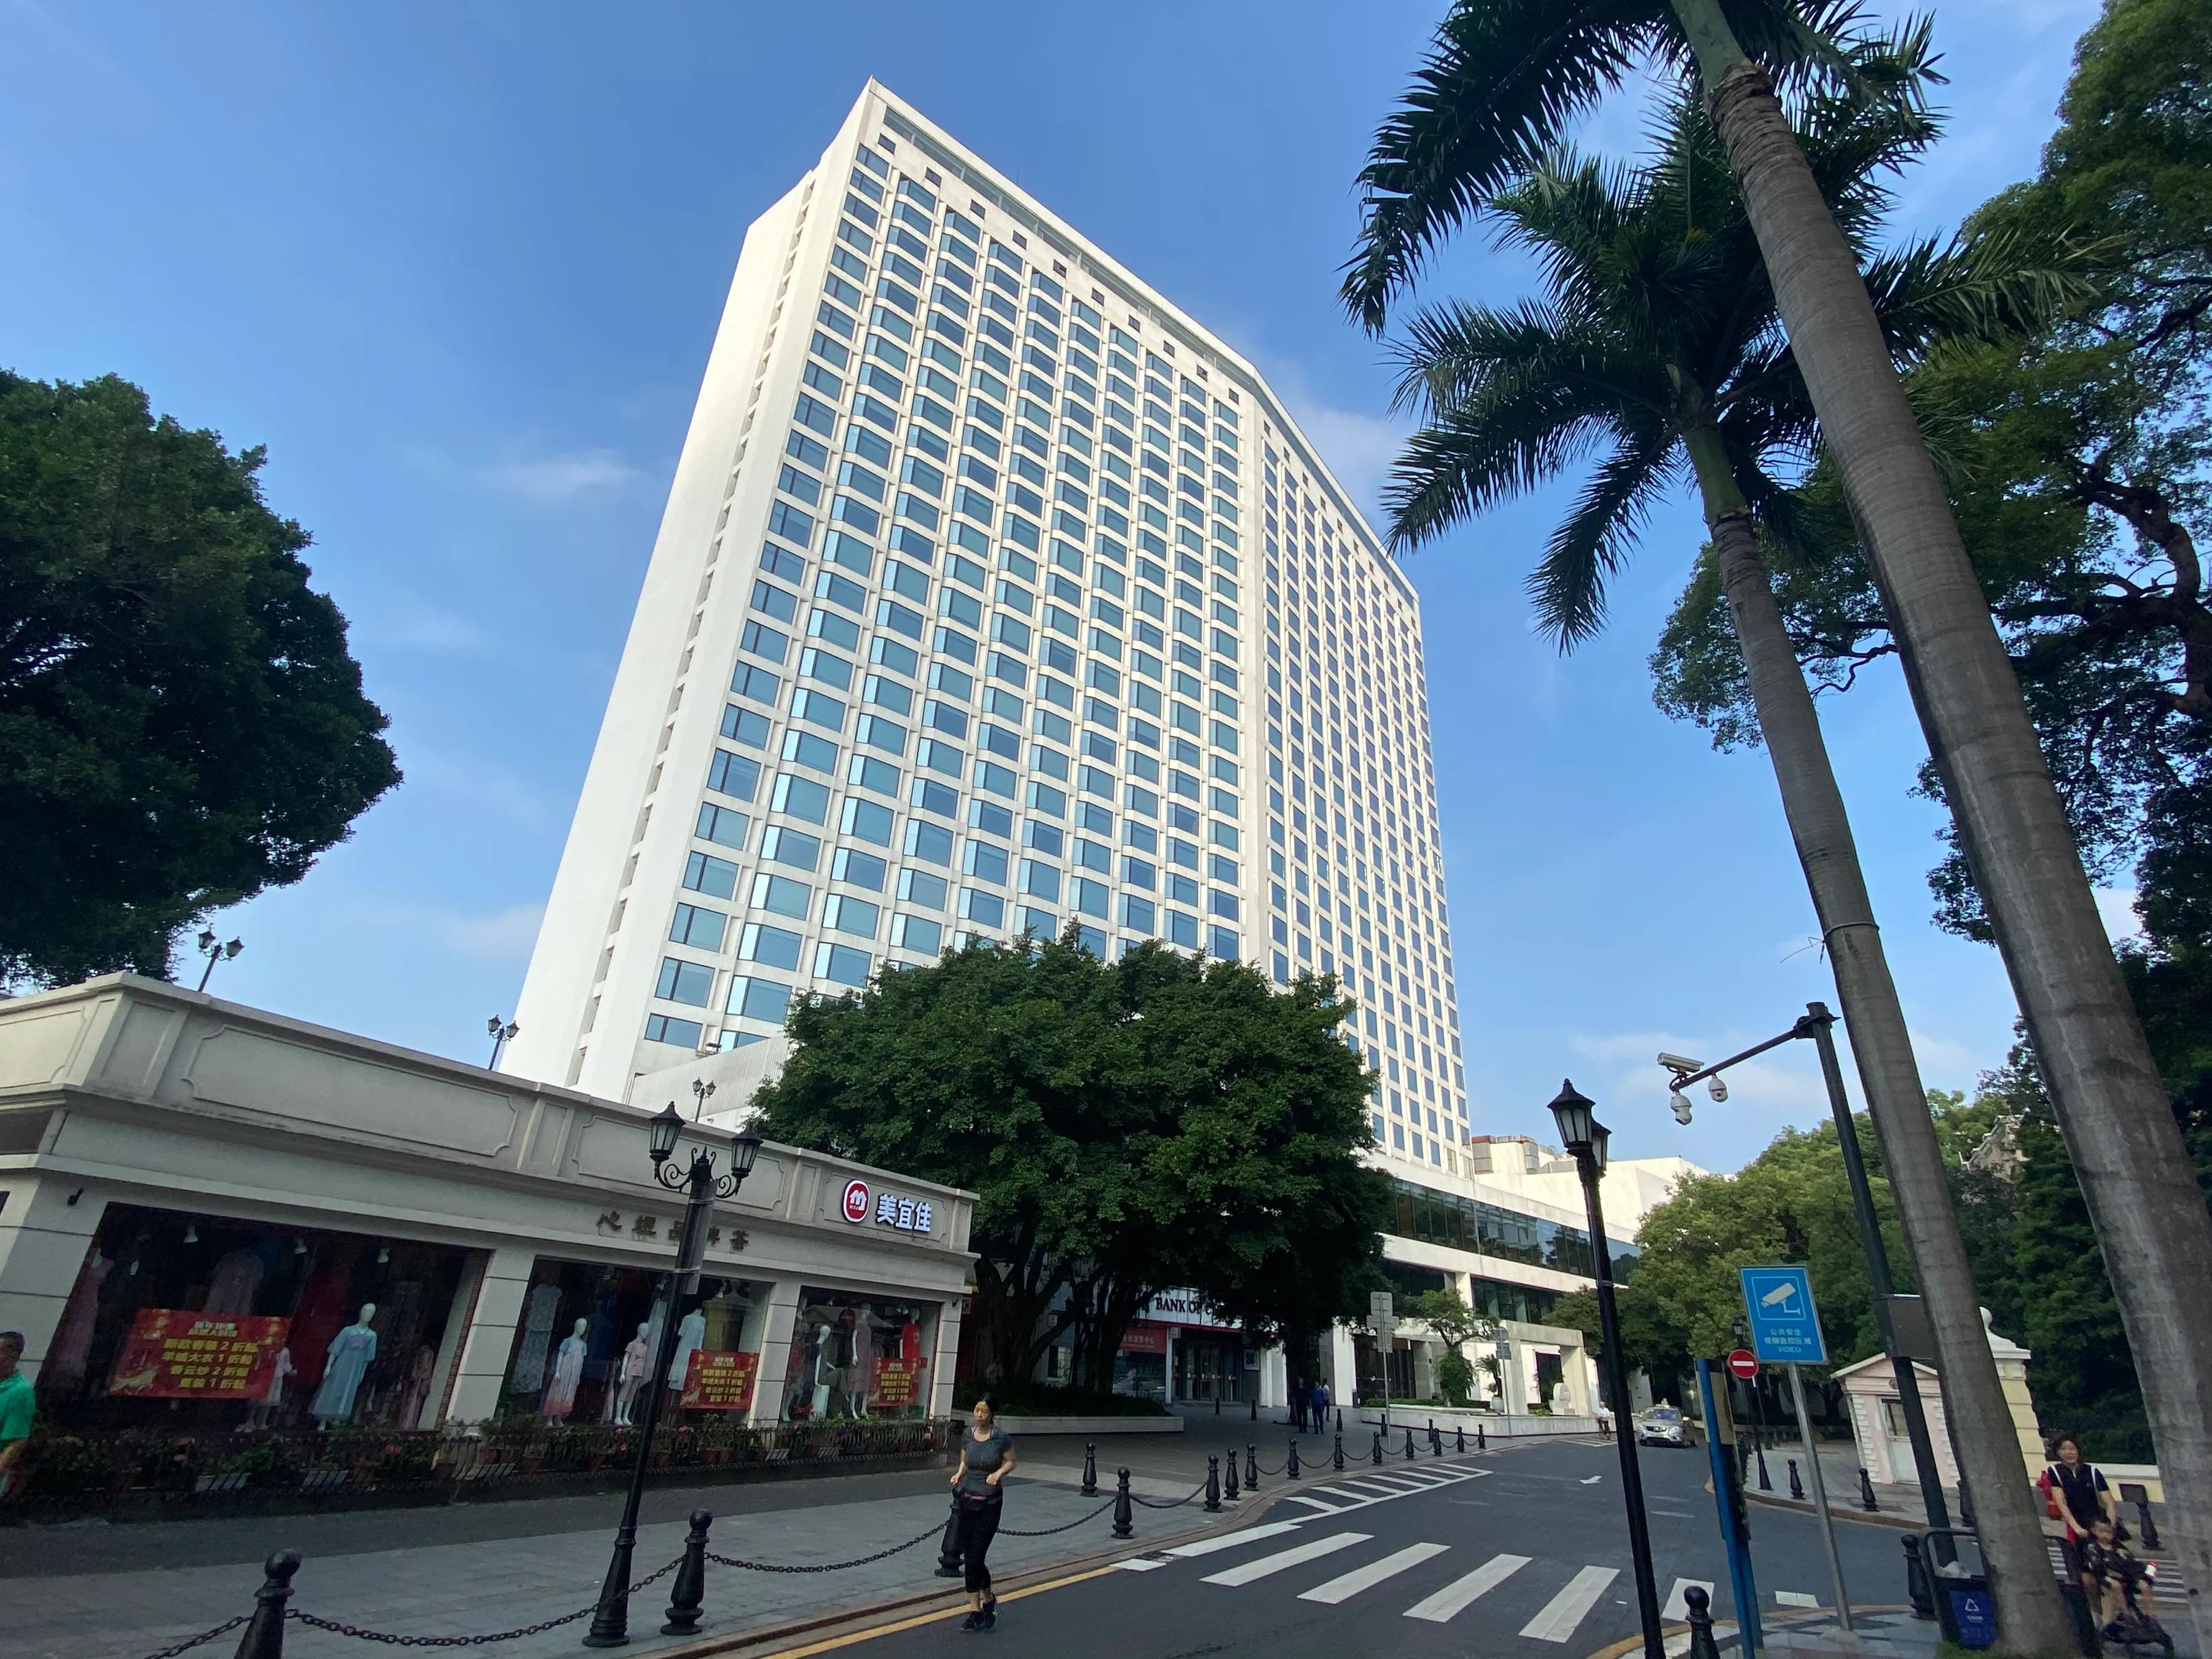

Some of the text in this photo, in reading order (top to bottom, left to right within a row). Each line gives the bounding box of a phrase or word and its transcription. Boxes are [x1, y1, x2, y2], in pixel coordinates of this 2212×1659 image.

[877, 1193, 932, 1232] 美宜佳
[1156, 1298, 1186, 1312] BANK
